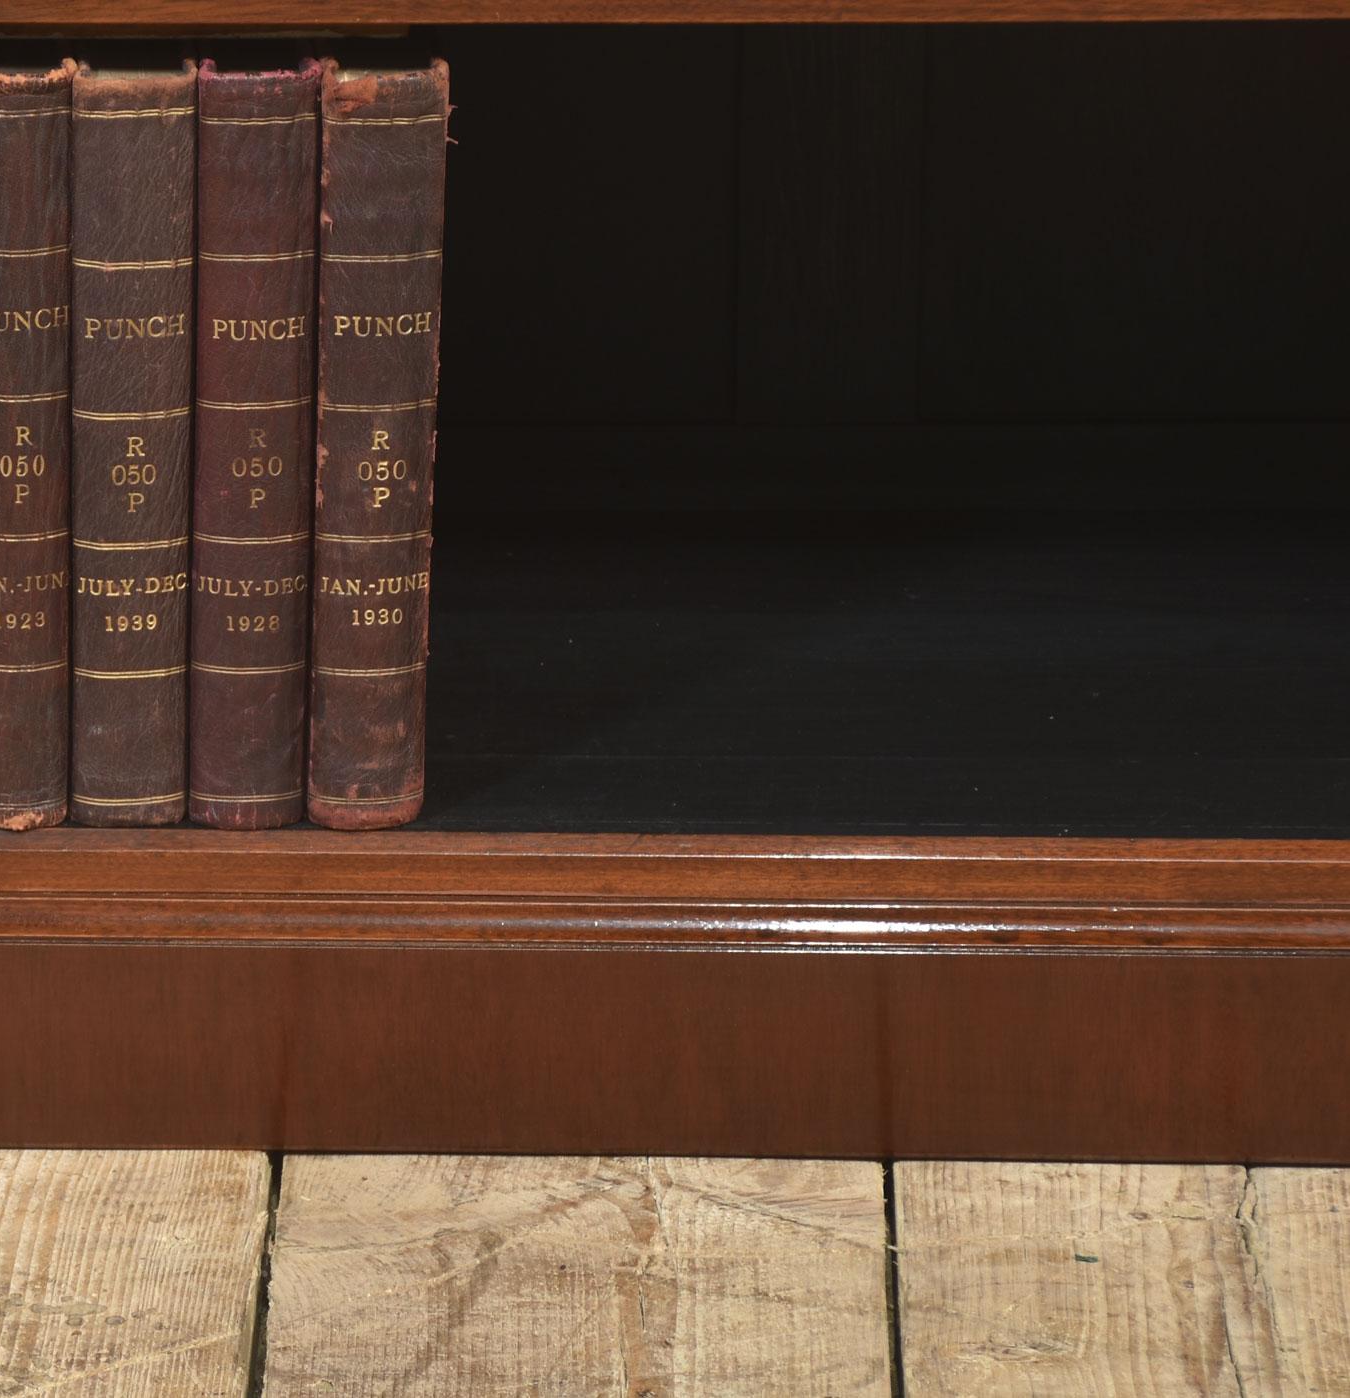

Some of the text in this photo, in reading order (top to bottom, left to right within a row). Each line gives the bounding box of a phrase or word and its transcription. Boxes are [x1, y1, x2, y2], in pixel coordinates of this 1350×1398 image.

[84, 313, 185, 340] PUNCH
[212, 315, 306, 341] PUNCH
[334, 311, 432, 337] PUNCH
[15, 426, 33, 446] R
[126, 436, 145, 457] R
[250, 428, 267, 448] R
[371, 430, 390, 450] R
[0, 454, 45, 477] 050
[112, 464, 157, 486] 050
[232, 456, 283, 478] 050
[358, 460, 407, 481] 050
[14, 484, 30, 504] P
[128, 492, 144, 513] P
[249, 488, 266, 508] P
[373, 487, 390, 508] P
[320, 571, 429, 596] JAN.-JUNE
[105, 613, 158, 632] 1939
[226, 615, 280, 632] 1928
[351, 608, 403, 626] 1930
